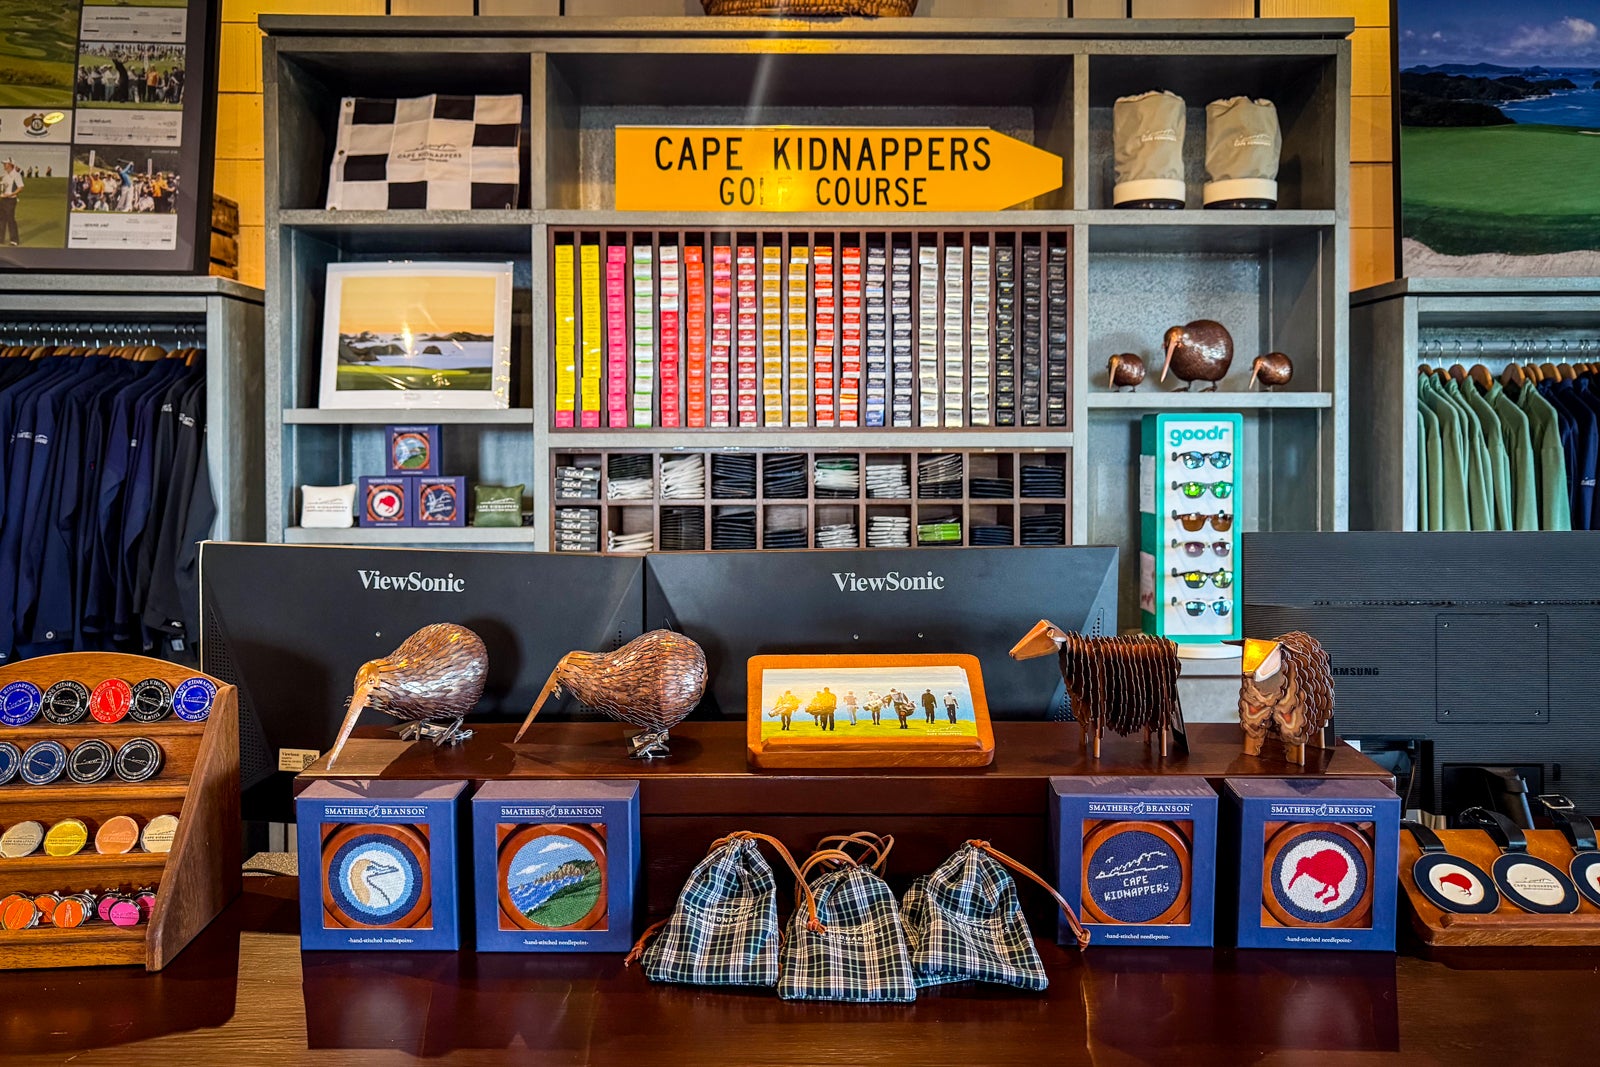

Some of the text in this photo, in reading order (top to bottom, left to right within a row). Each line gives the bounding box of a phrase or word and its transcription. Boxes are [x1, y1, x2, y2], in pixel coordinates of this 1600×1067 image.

[655, 136, 991, 171] CAPE KIDNAPPERS
[816, 177, 928, 206] COURSE
[1170, 426, 1229, 447] goodr
[357, 570, 465, 592] ViewSonic
[832, 571, 945, 592] ViewSonic
[1331, 667, 1380, 676] AMSUNG
[324, 805, 425, 818] SMATHERS & BRANSON
[501, 805, 602, 818] SMATHERS & BRANSON
[1089, 802, 1190, 814] SMATHERS & BRANSON
[1315, 803, 1328, 816] &
[1328, 806, 1373, 814] BRANSON
[1123, 875, 1149, 887] CAPE
[1104, 882, 1170, 901] KIDNAPPERS
